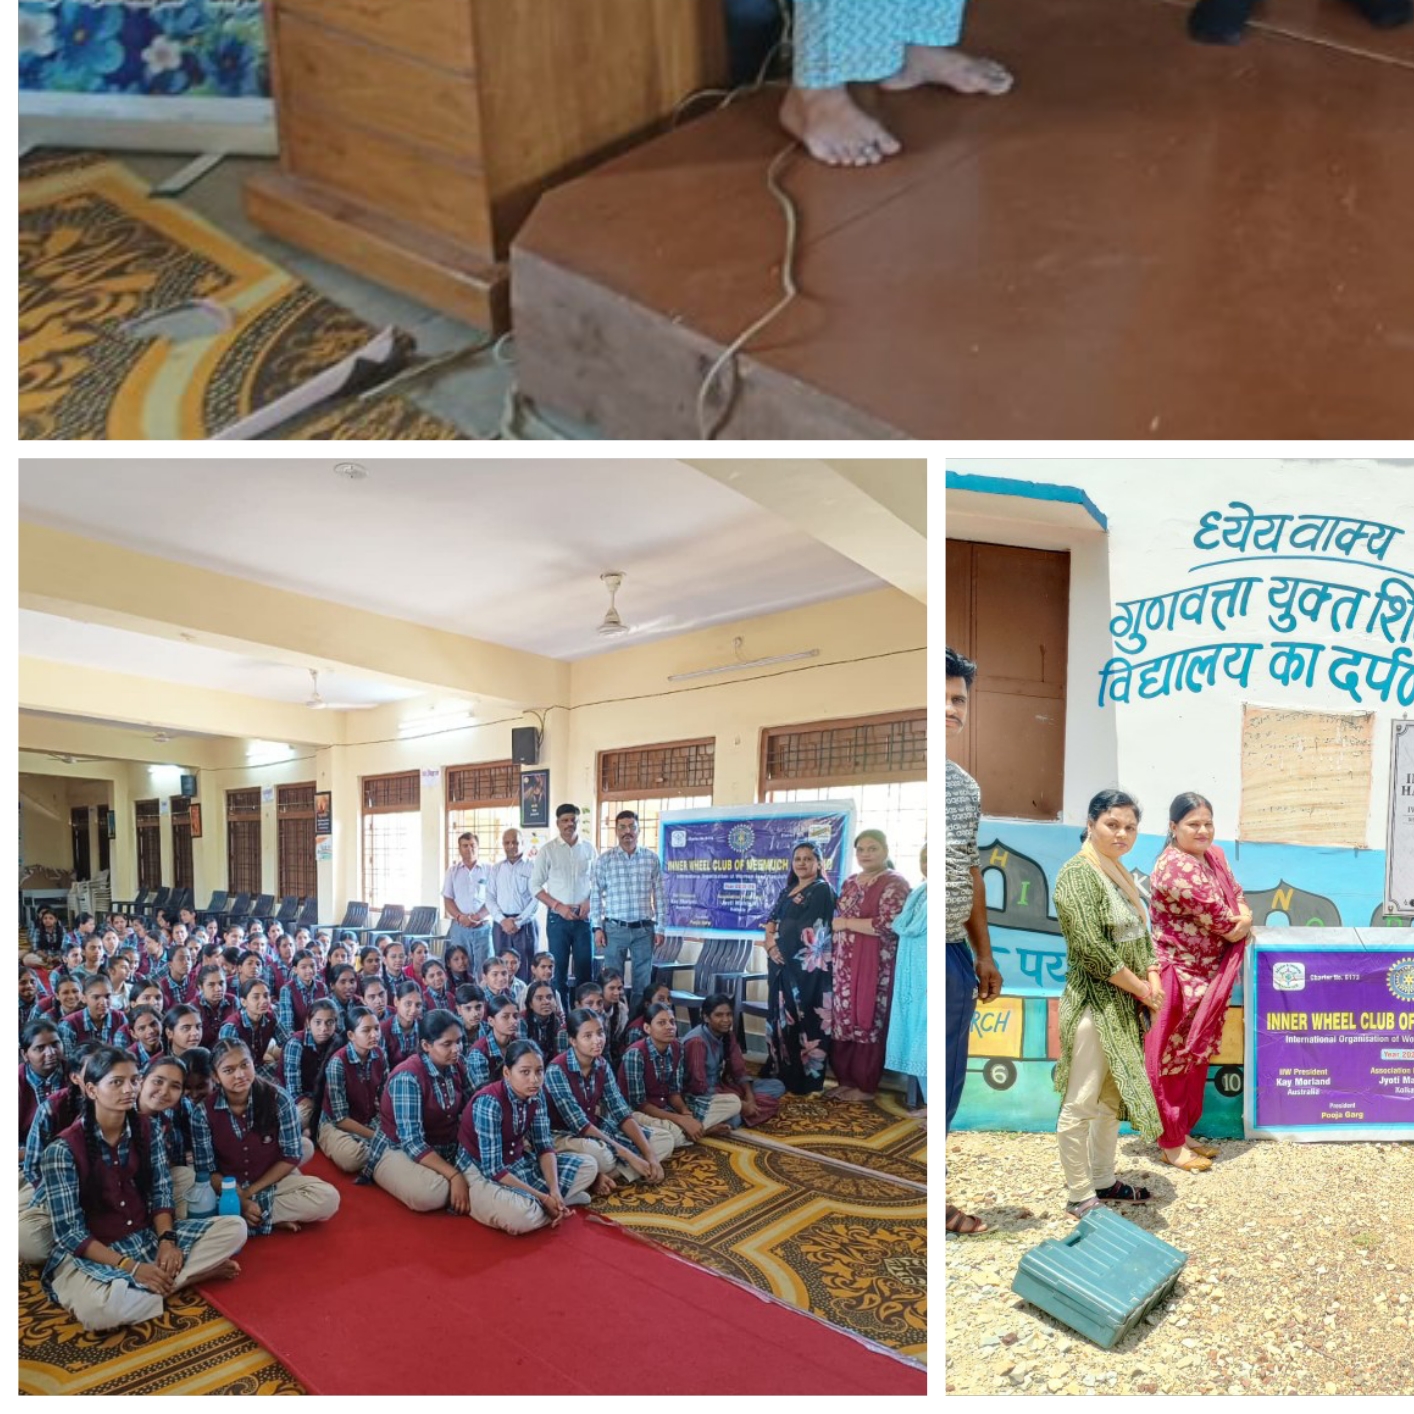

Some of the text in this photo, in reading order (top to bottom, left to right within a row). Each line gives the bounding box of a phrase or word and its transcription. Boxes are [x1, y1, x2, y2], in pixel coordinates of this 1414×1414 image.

[1193, 501, 1405, 561] ध्येय वाक्य
[1109, 576, 1263, 655] गुणवत्ता
[1268, 576, 1371, 633] युक्त
[1097, 643, 1264, 707] विद्यालय
[1269, 641, 1326, 687] का
[712, 859, 732, 871] CLUB
[734, 859, 745, 871] OF
[989, 848, 1008, 868] H
[1271, 888, 1294, 910] N
[1267, 1013, 1308, 1030] INNER
[1311, 1012, 1356, 1030] WHEEL
[1360, 1012, 1395, 1030] CLUB
[1285, 1035, 1336, 1044] International
[1339, 1035, 1389, 1045] Organisation
[992, 1063, 1007, 1084] 6
[1294, 1068, 1328, 1076] President
[1370, 1066, 1412, 1074] Association
[1223, 1073, 1242, 1091] 10
[1276, 1078, 1292, 1087] Kay
[1379, 1076, 1400, 1086] Jyoti
[1322, 1111, 1364, 1120] Pooja Garg
